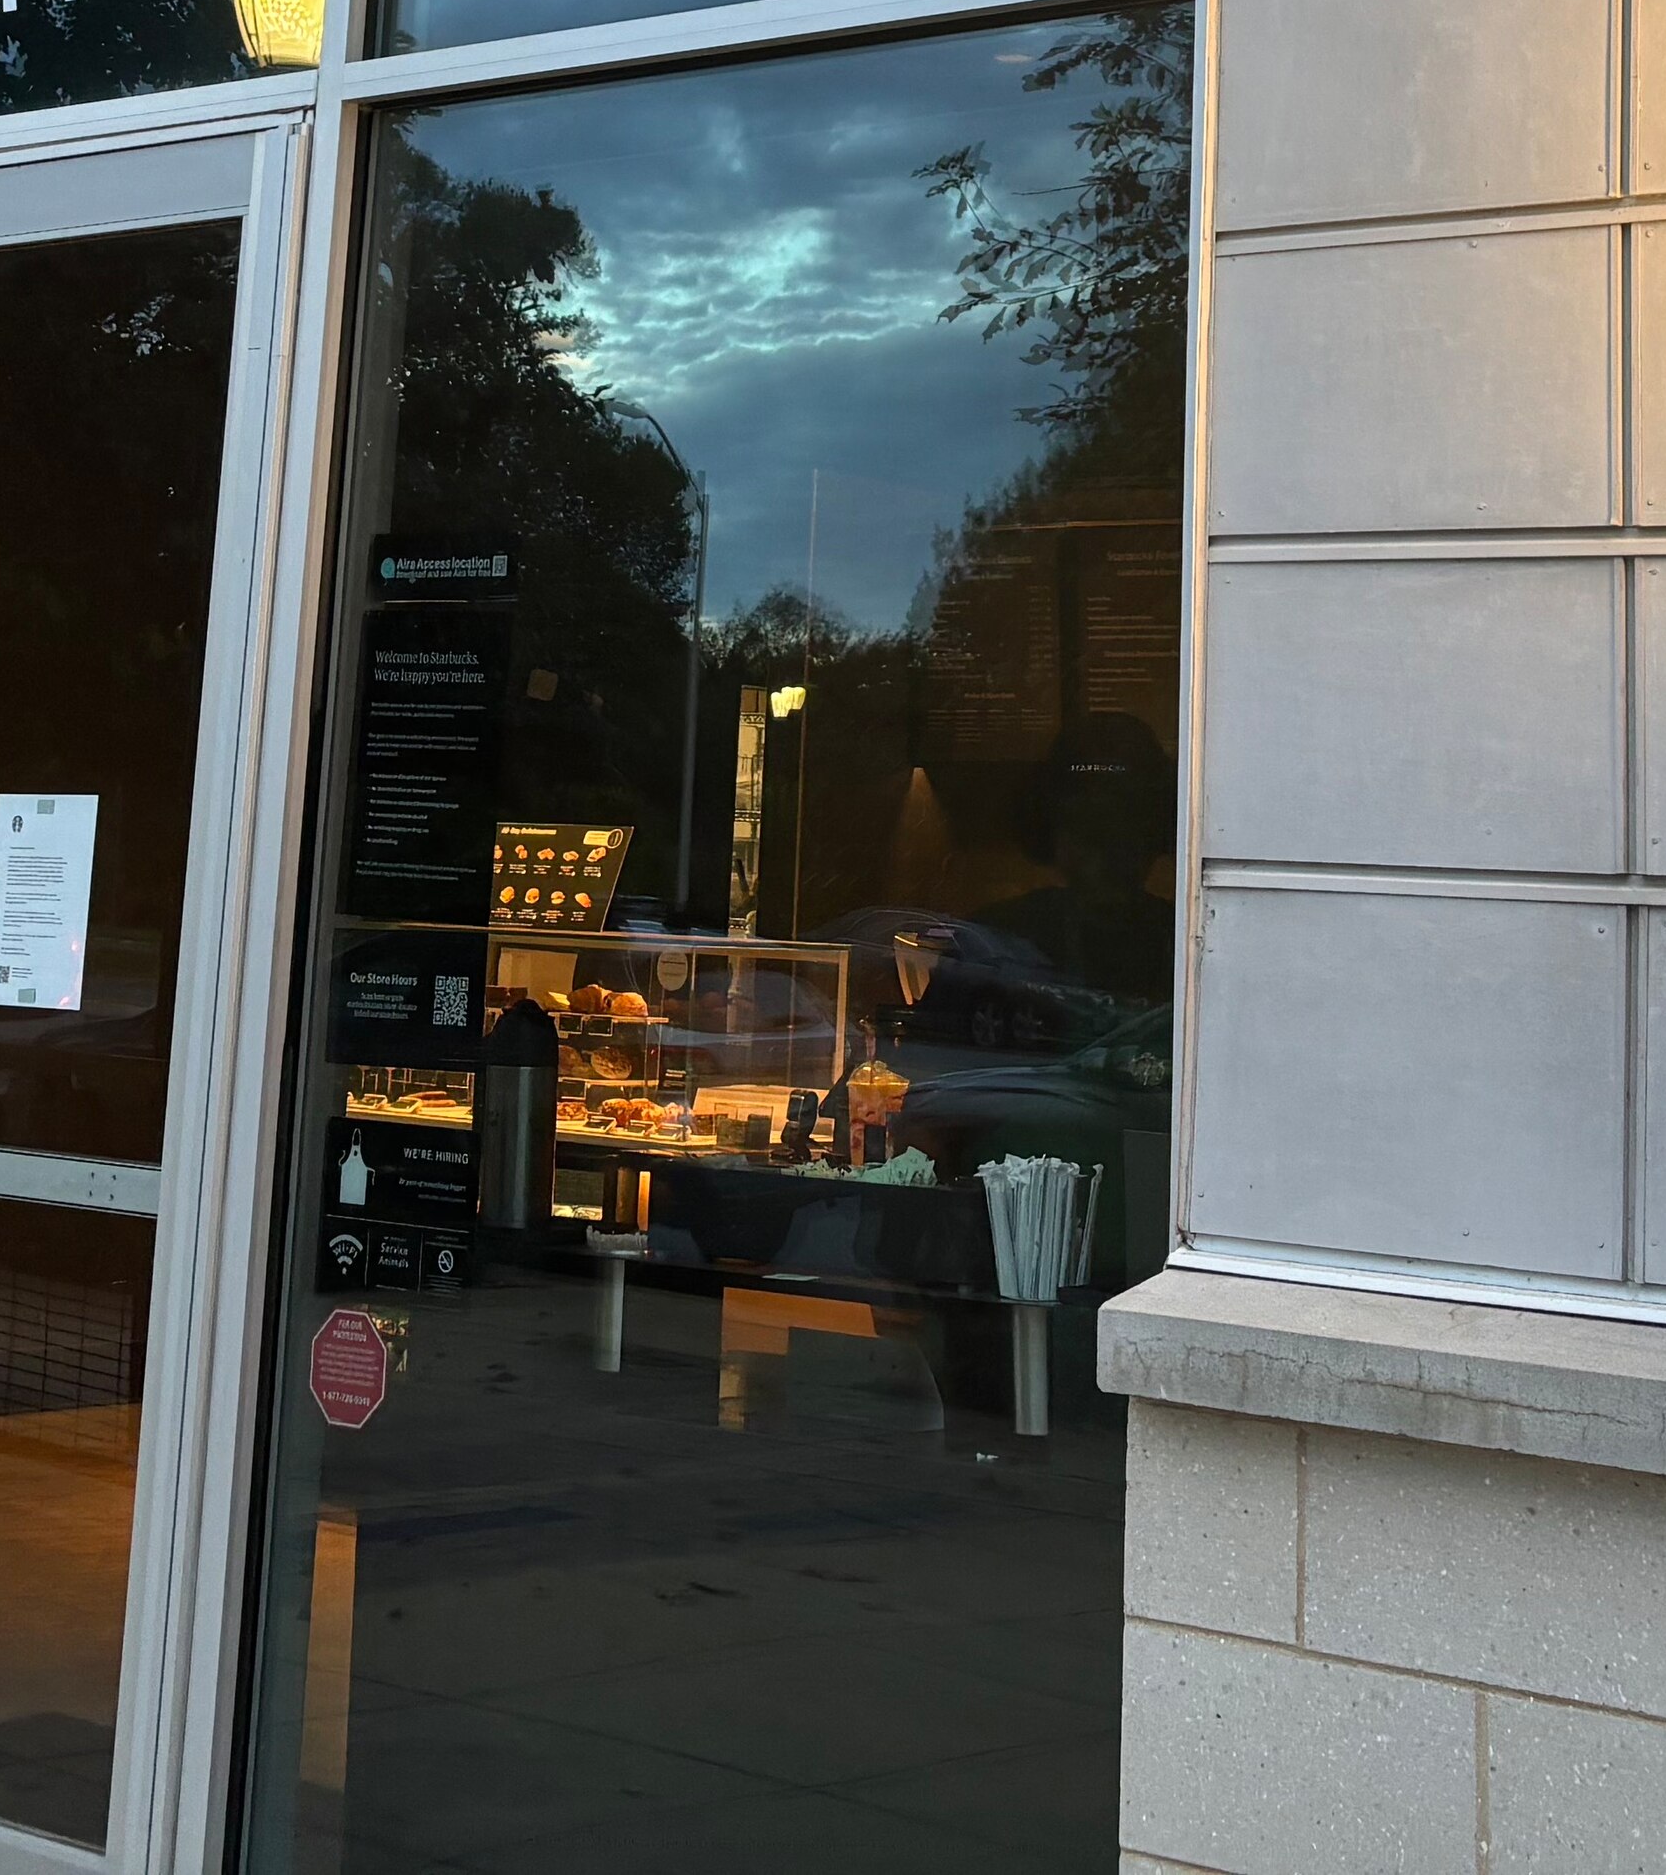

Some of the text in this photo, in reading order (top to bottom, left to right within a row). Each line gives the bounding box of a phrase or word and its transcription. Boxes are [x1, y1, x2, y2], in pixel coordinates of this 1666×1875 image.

[451, 555, 491, 570] location
[375, 649, 479, 665] Welcome to Starbucks.
[401, 668, 431, 685] happy
[349, 971, 419, 988] Our Store Hours
[402, 1146, 470, 1165] WE'RE HIRING
